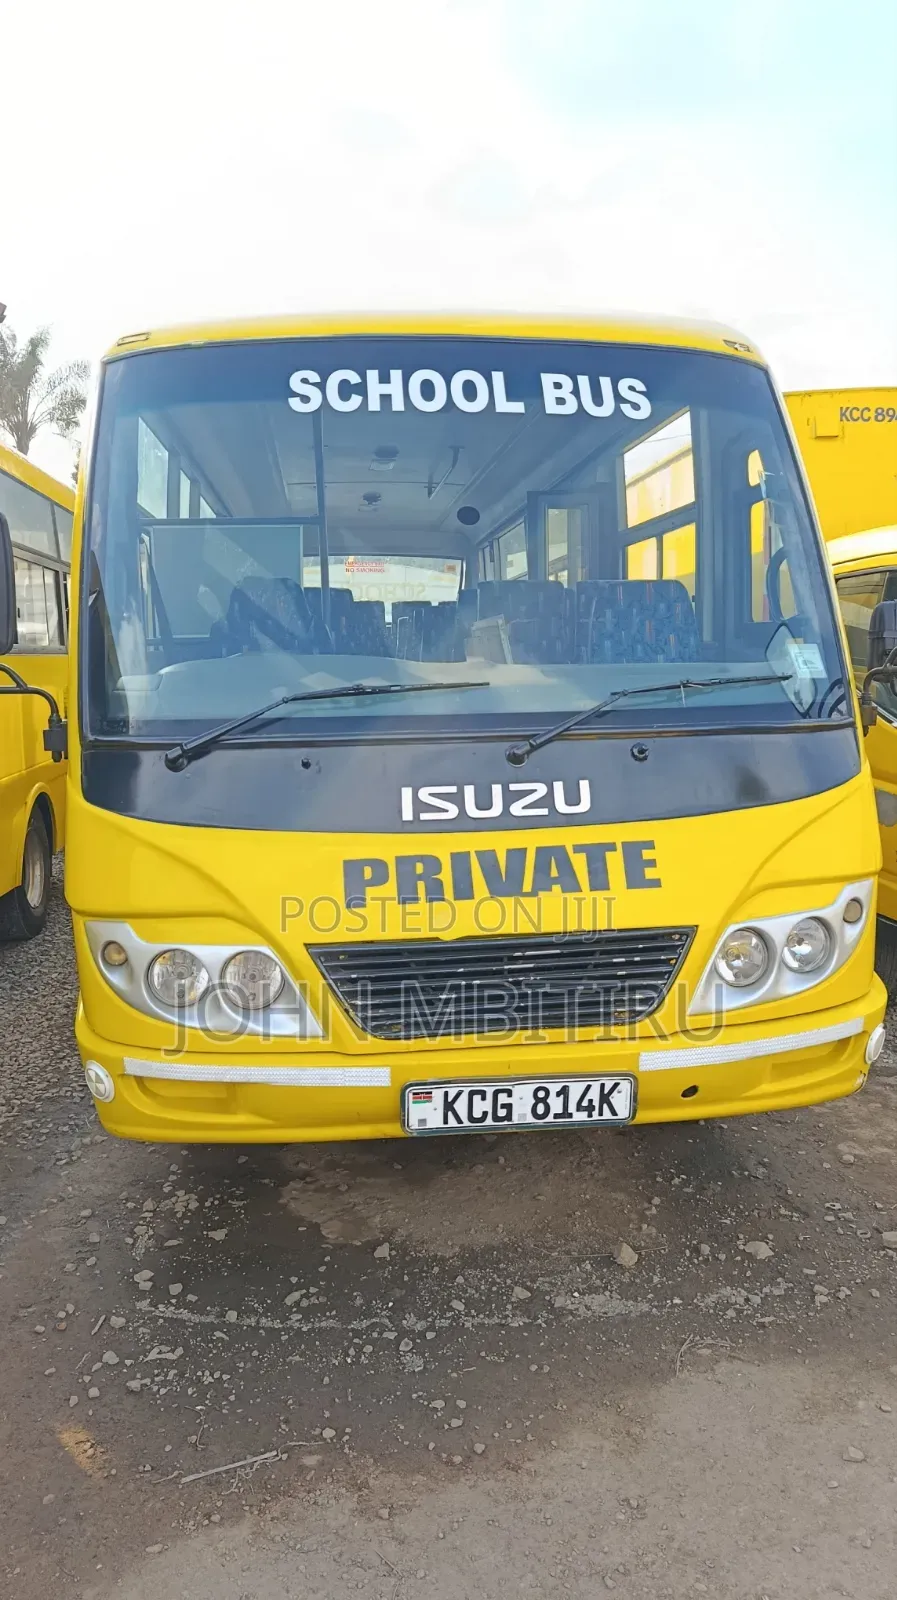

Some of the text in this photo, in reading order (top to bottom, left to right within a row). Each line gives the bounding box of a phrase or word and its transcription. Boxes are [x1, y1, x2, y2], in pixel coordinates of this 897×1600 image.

[288, 369, 652, 420] SCHOOL BUS
[840, 407, 897, 423] KCC 89
[401, 780, 591, 821] ISUZU
[342, 840, 662, 908] PRIVATE
[442, 1088, 514, 1125] KCG
[530, 1082, 621, 1121] 814K
